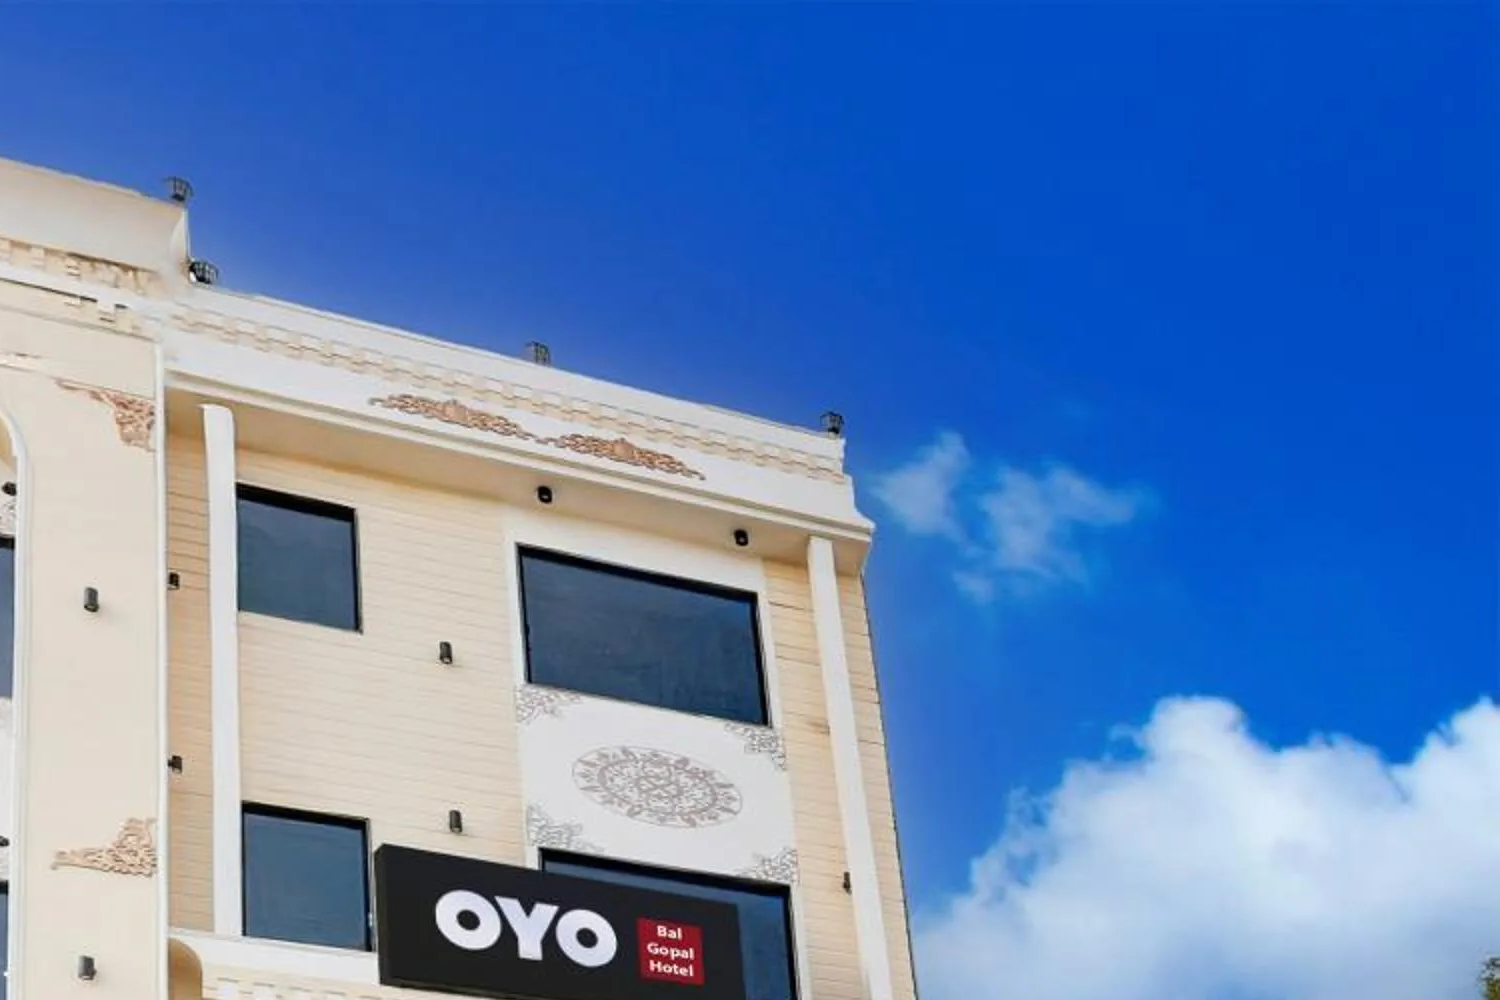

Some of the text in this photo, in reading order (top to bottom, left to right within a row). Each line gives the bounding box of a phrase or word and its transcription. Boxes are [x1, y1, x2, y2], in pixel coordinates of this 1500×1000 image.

[435, 889, 618, 967] OYO
[656, 925, 682, 940] Bal
[647, 942, 695, 961] Gopal
[649, 959, 694, 977] Hotel
